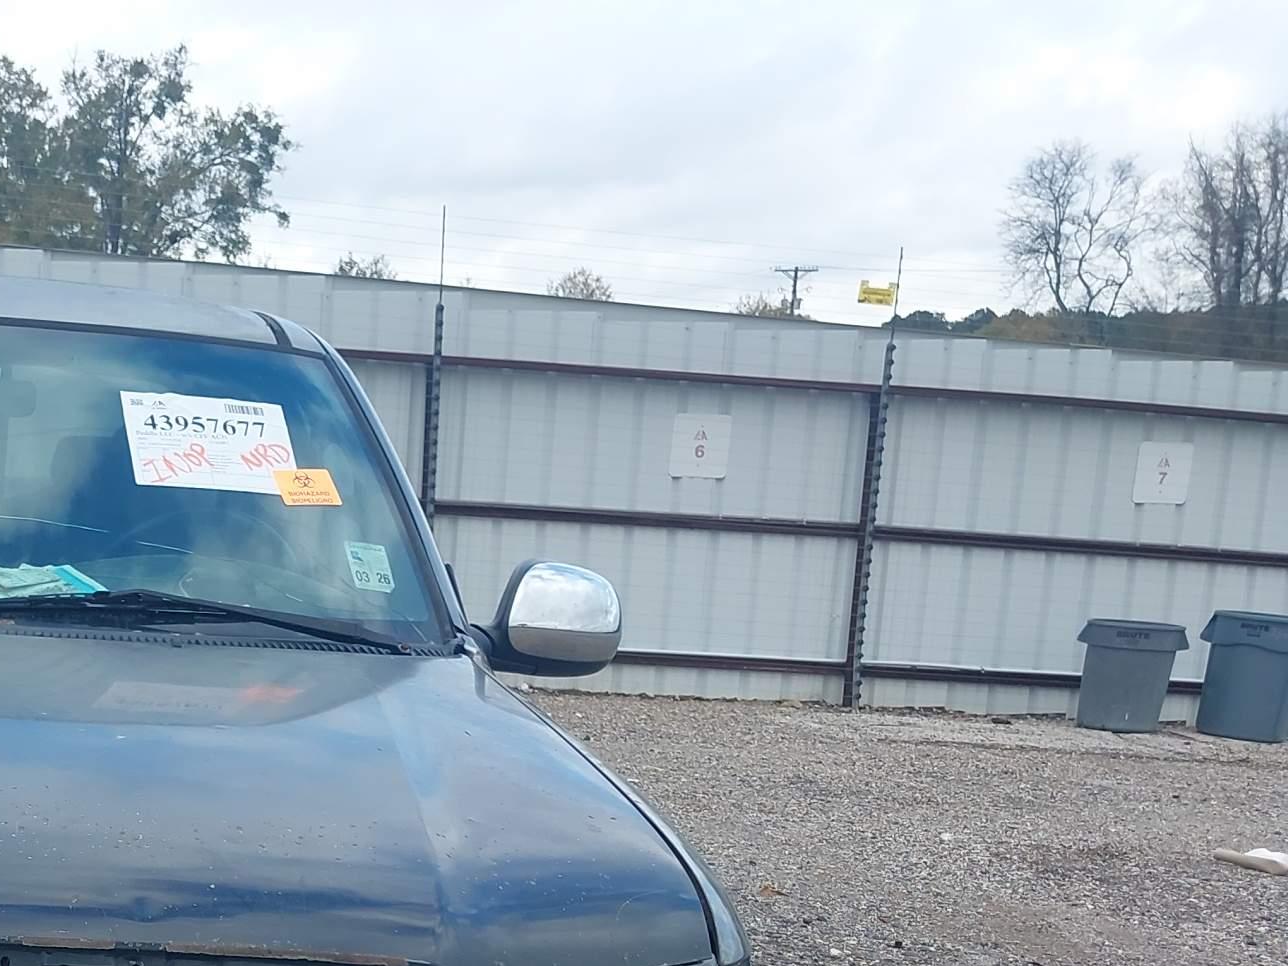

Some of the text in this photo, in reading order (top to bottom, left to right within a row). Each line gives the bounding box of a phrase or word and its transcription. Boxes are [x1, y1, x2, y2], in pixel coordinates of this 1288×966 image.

[143, 413, 265, 438] 43957677
[695, 445, 705, 458] 6
[1158, 472, 1168, 485] 7
[355, 570, 391, 585] 03 26
[1116, 630, 1151, 639] BRUTE
